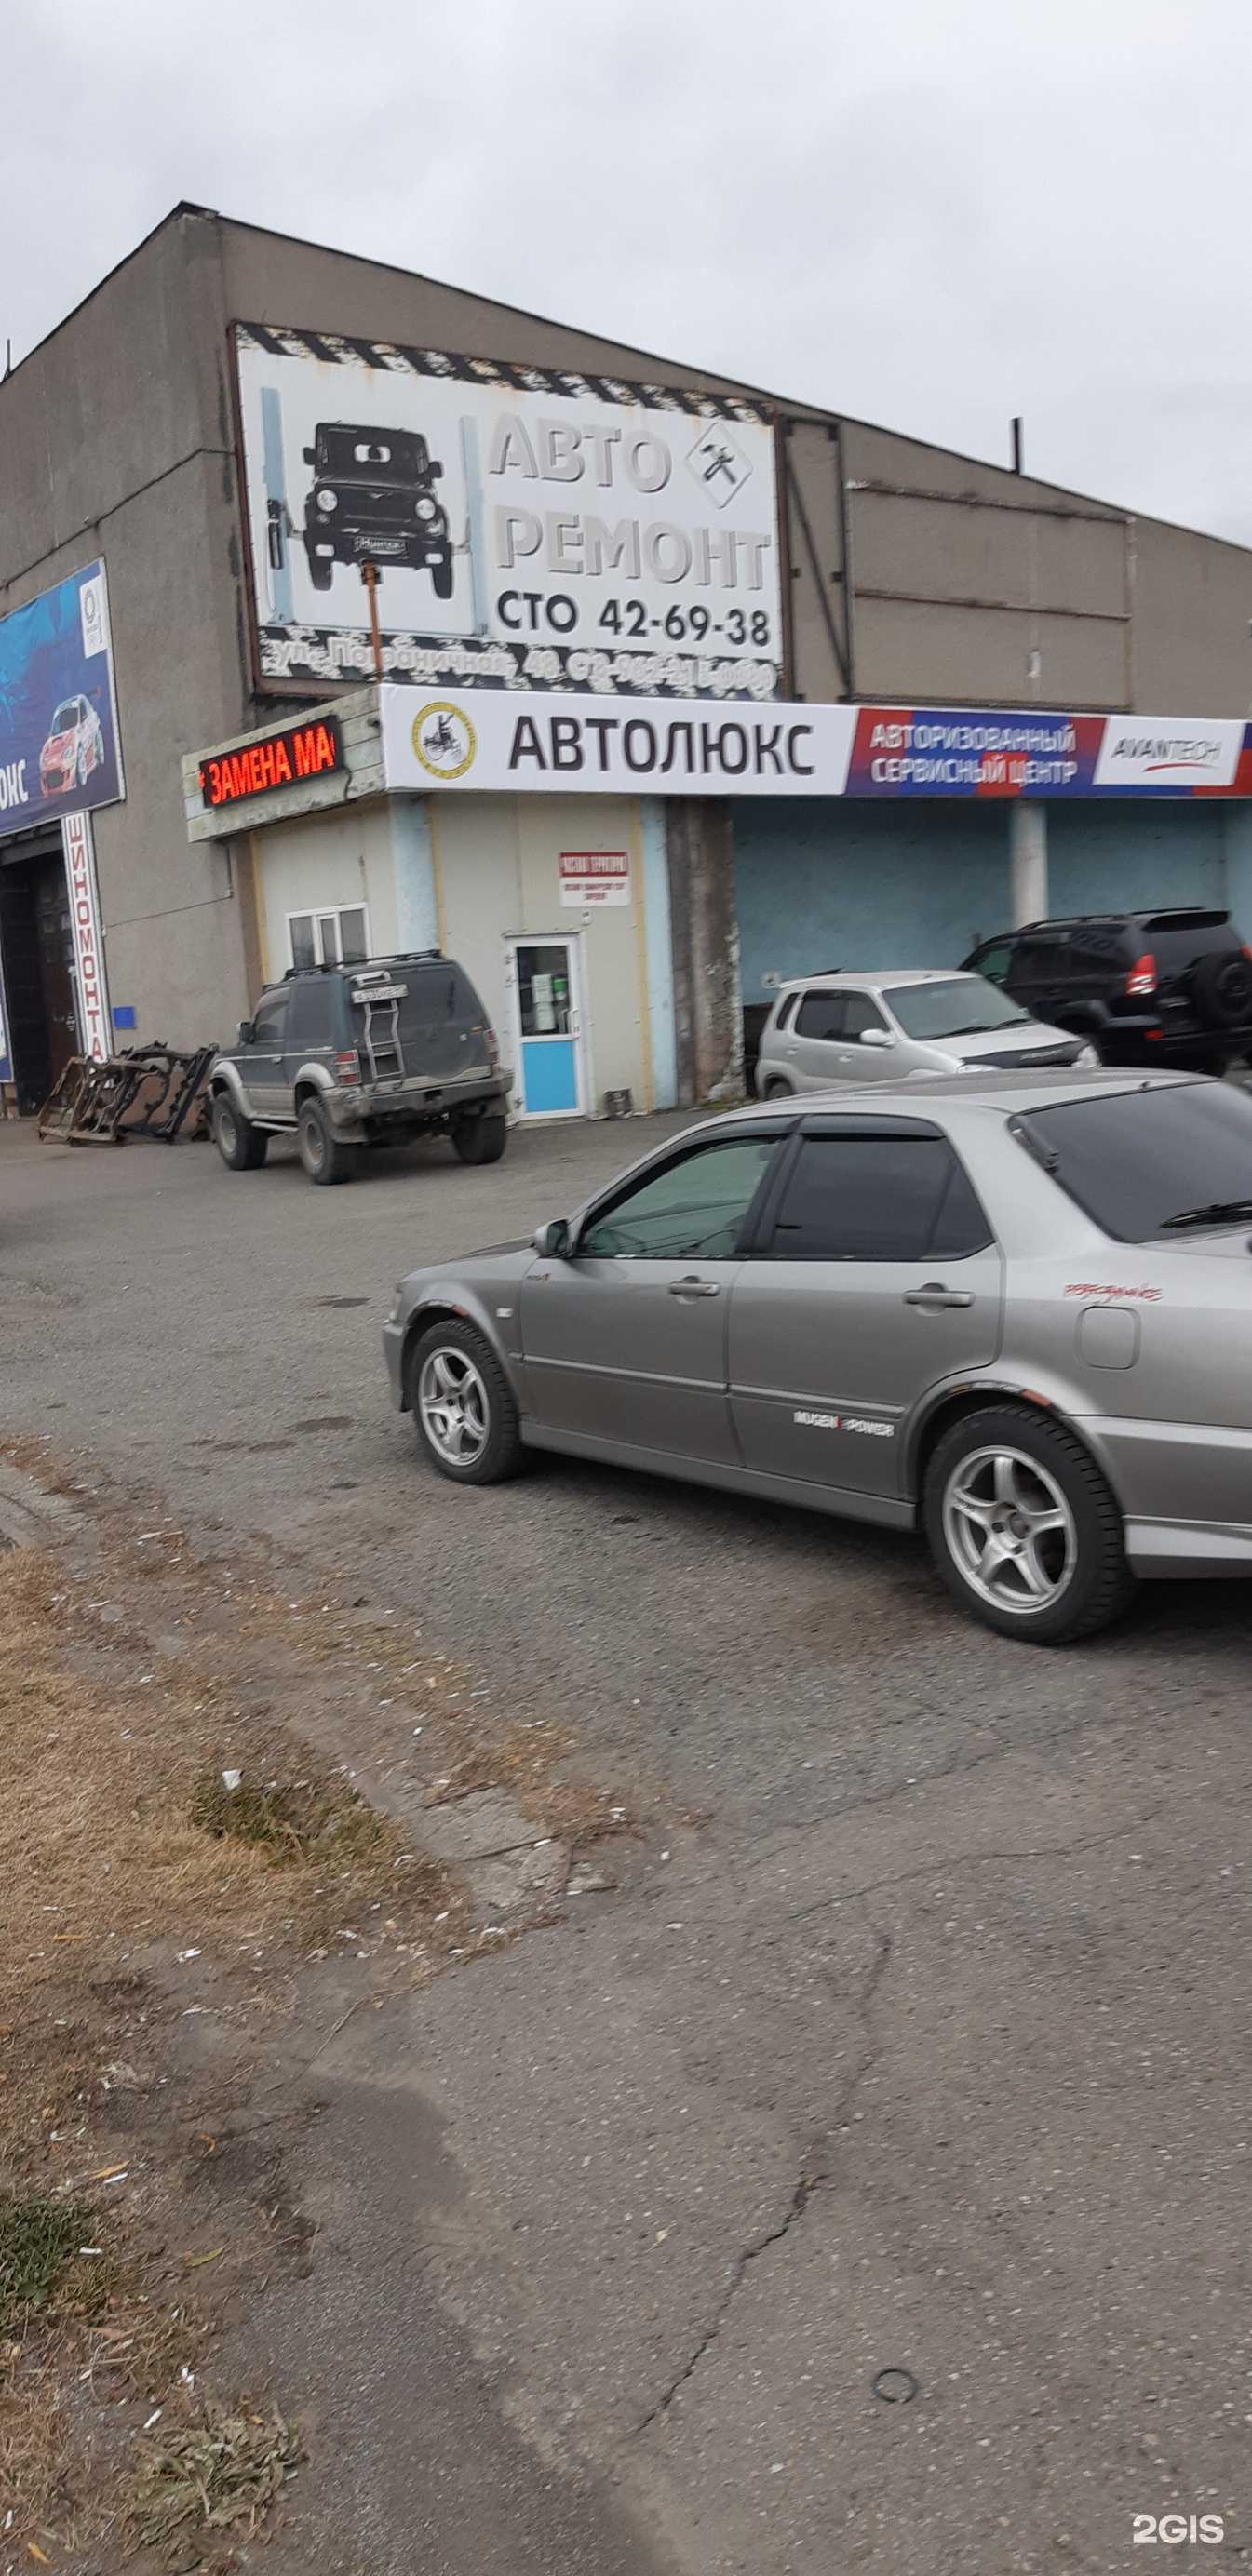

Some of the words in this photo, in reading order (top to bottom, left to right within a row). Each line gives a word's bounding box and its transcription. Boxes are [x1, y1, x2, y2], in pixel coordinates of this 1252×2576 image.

[488, 410, 672, 493] АВТО
[493, 503, 772, 591] РЕМОНТ
[497, 589, 579, 634] СТО
[599, 598, 771, 648] 42-69-38
[208, 739, 293, 805] ЗАМЕНА
[293, 725, 336, 777] МА
[507, 715, 815, 776] АВТОЛЮКС
[869, 723, 1077, 753] АВТОРИЗОВАННЫЙ
[1111, 737, 1222, 760] AVANTECH
[870, 754, 1006, 784] СЕРВИСНЫЙ
[1007, 760, 1079, 785] ЦЕНТР
